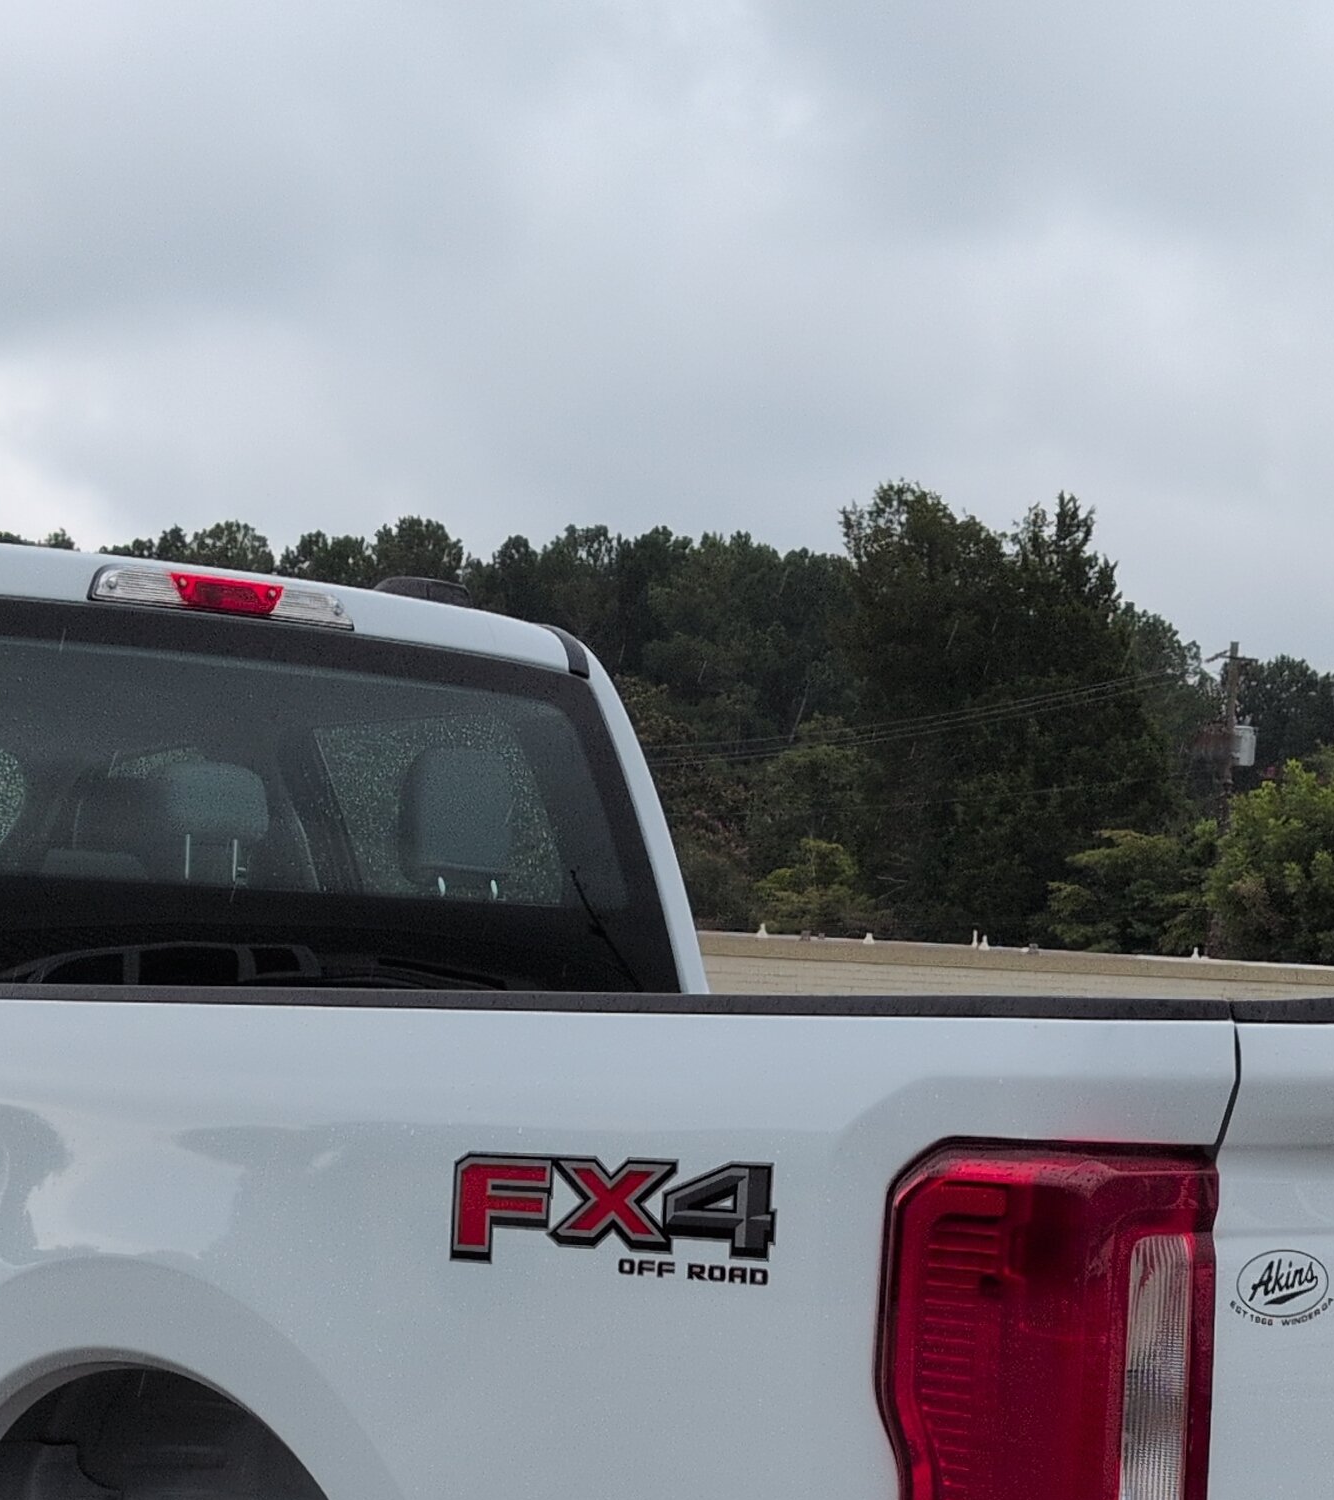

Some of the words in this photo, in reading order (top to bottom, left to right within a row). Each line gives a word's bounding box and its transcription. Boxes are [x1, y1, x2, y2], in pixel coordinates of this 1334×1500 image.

[449, 1151, 777, 1263] FX4
[617, 1258, 676, 1279] OFF
[686, 1262, 769, 1286] ROAD
[1248, 1258, 1319, 1305] Akins
